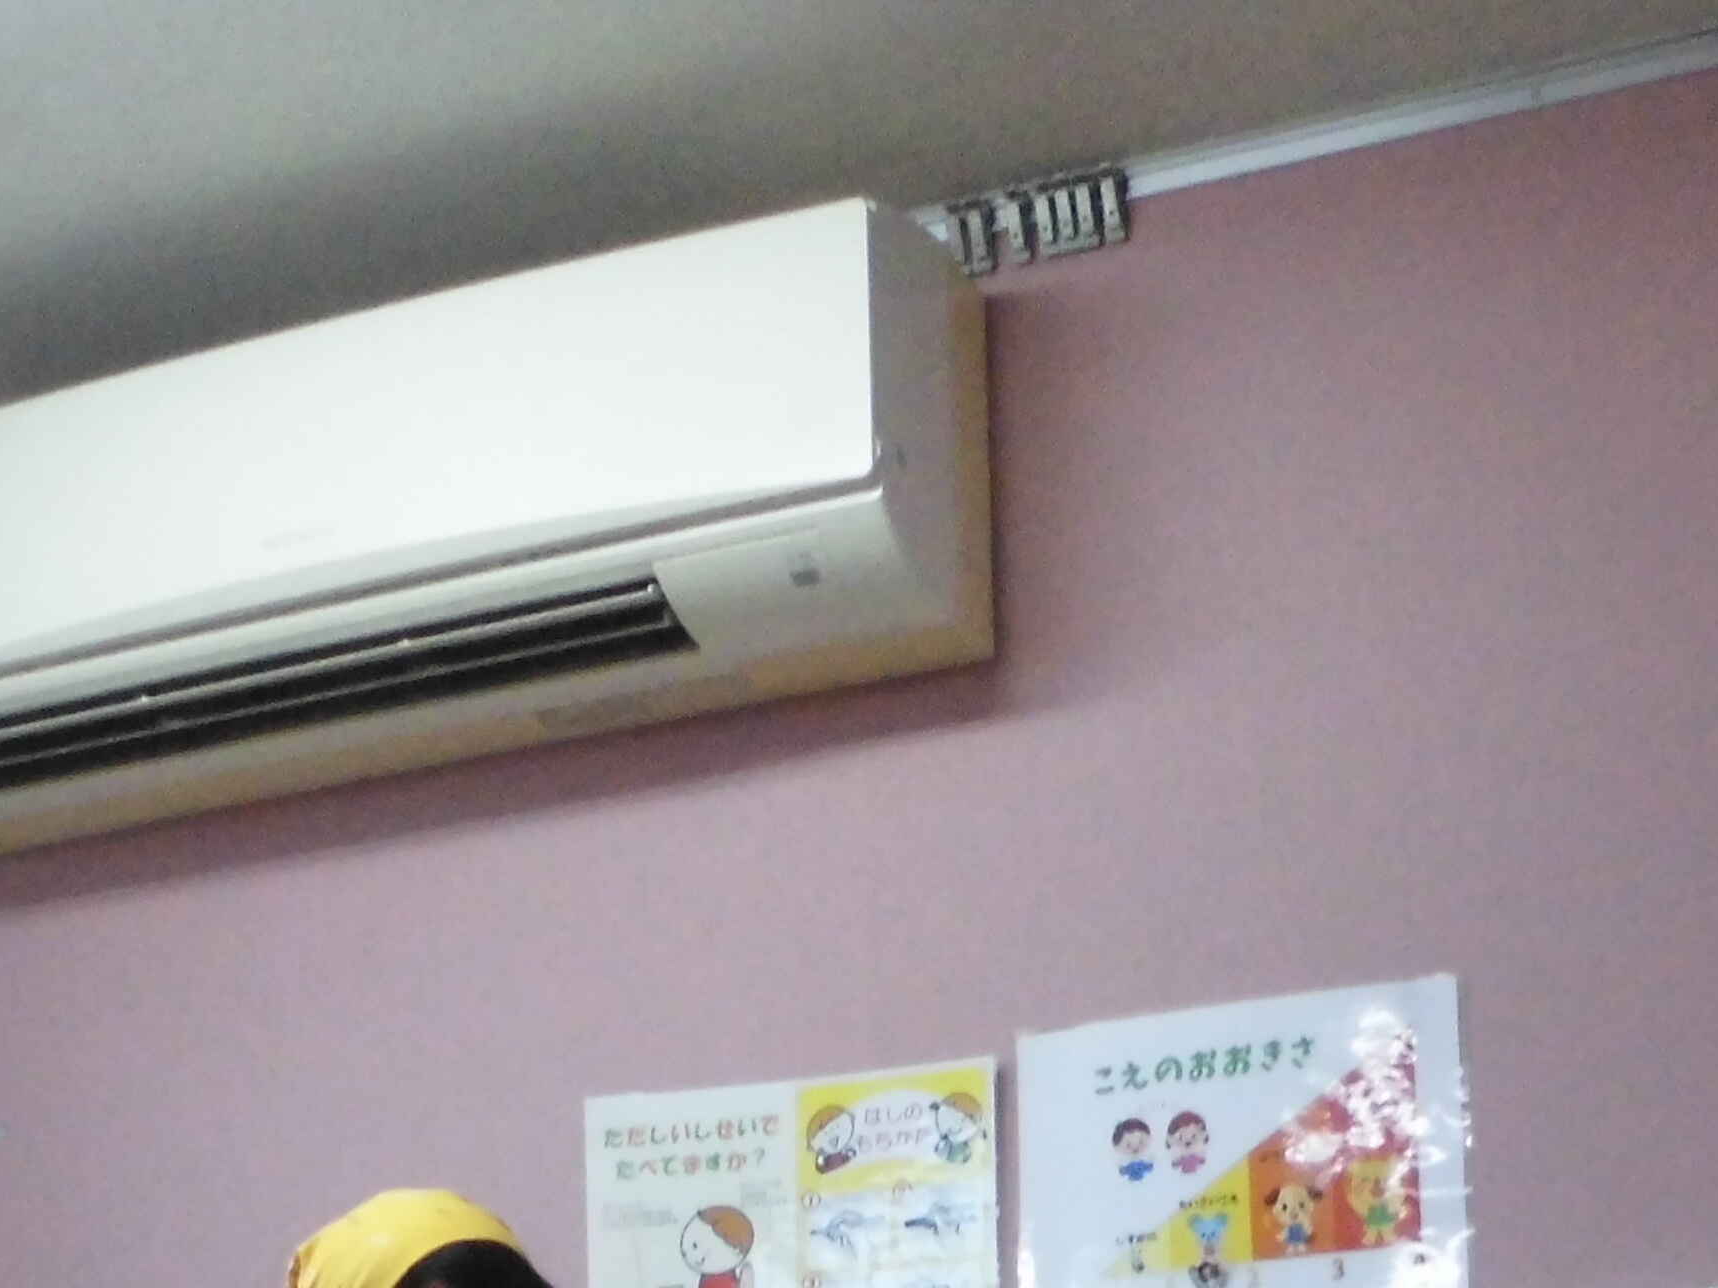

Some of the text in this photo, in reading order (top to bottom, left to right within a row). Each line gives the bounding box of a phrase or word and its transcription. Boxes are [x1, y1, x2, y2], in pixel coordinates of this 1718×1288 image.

[1095, 1034, 1315, 1096] こえのおおきさ
[603, 1114, 780, 1150] ただしいしせいで
